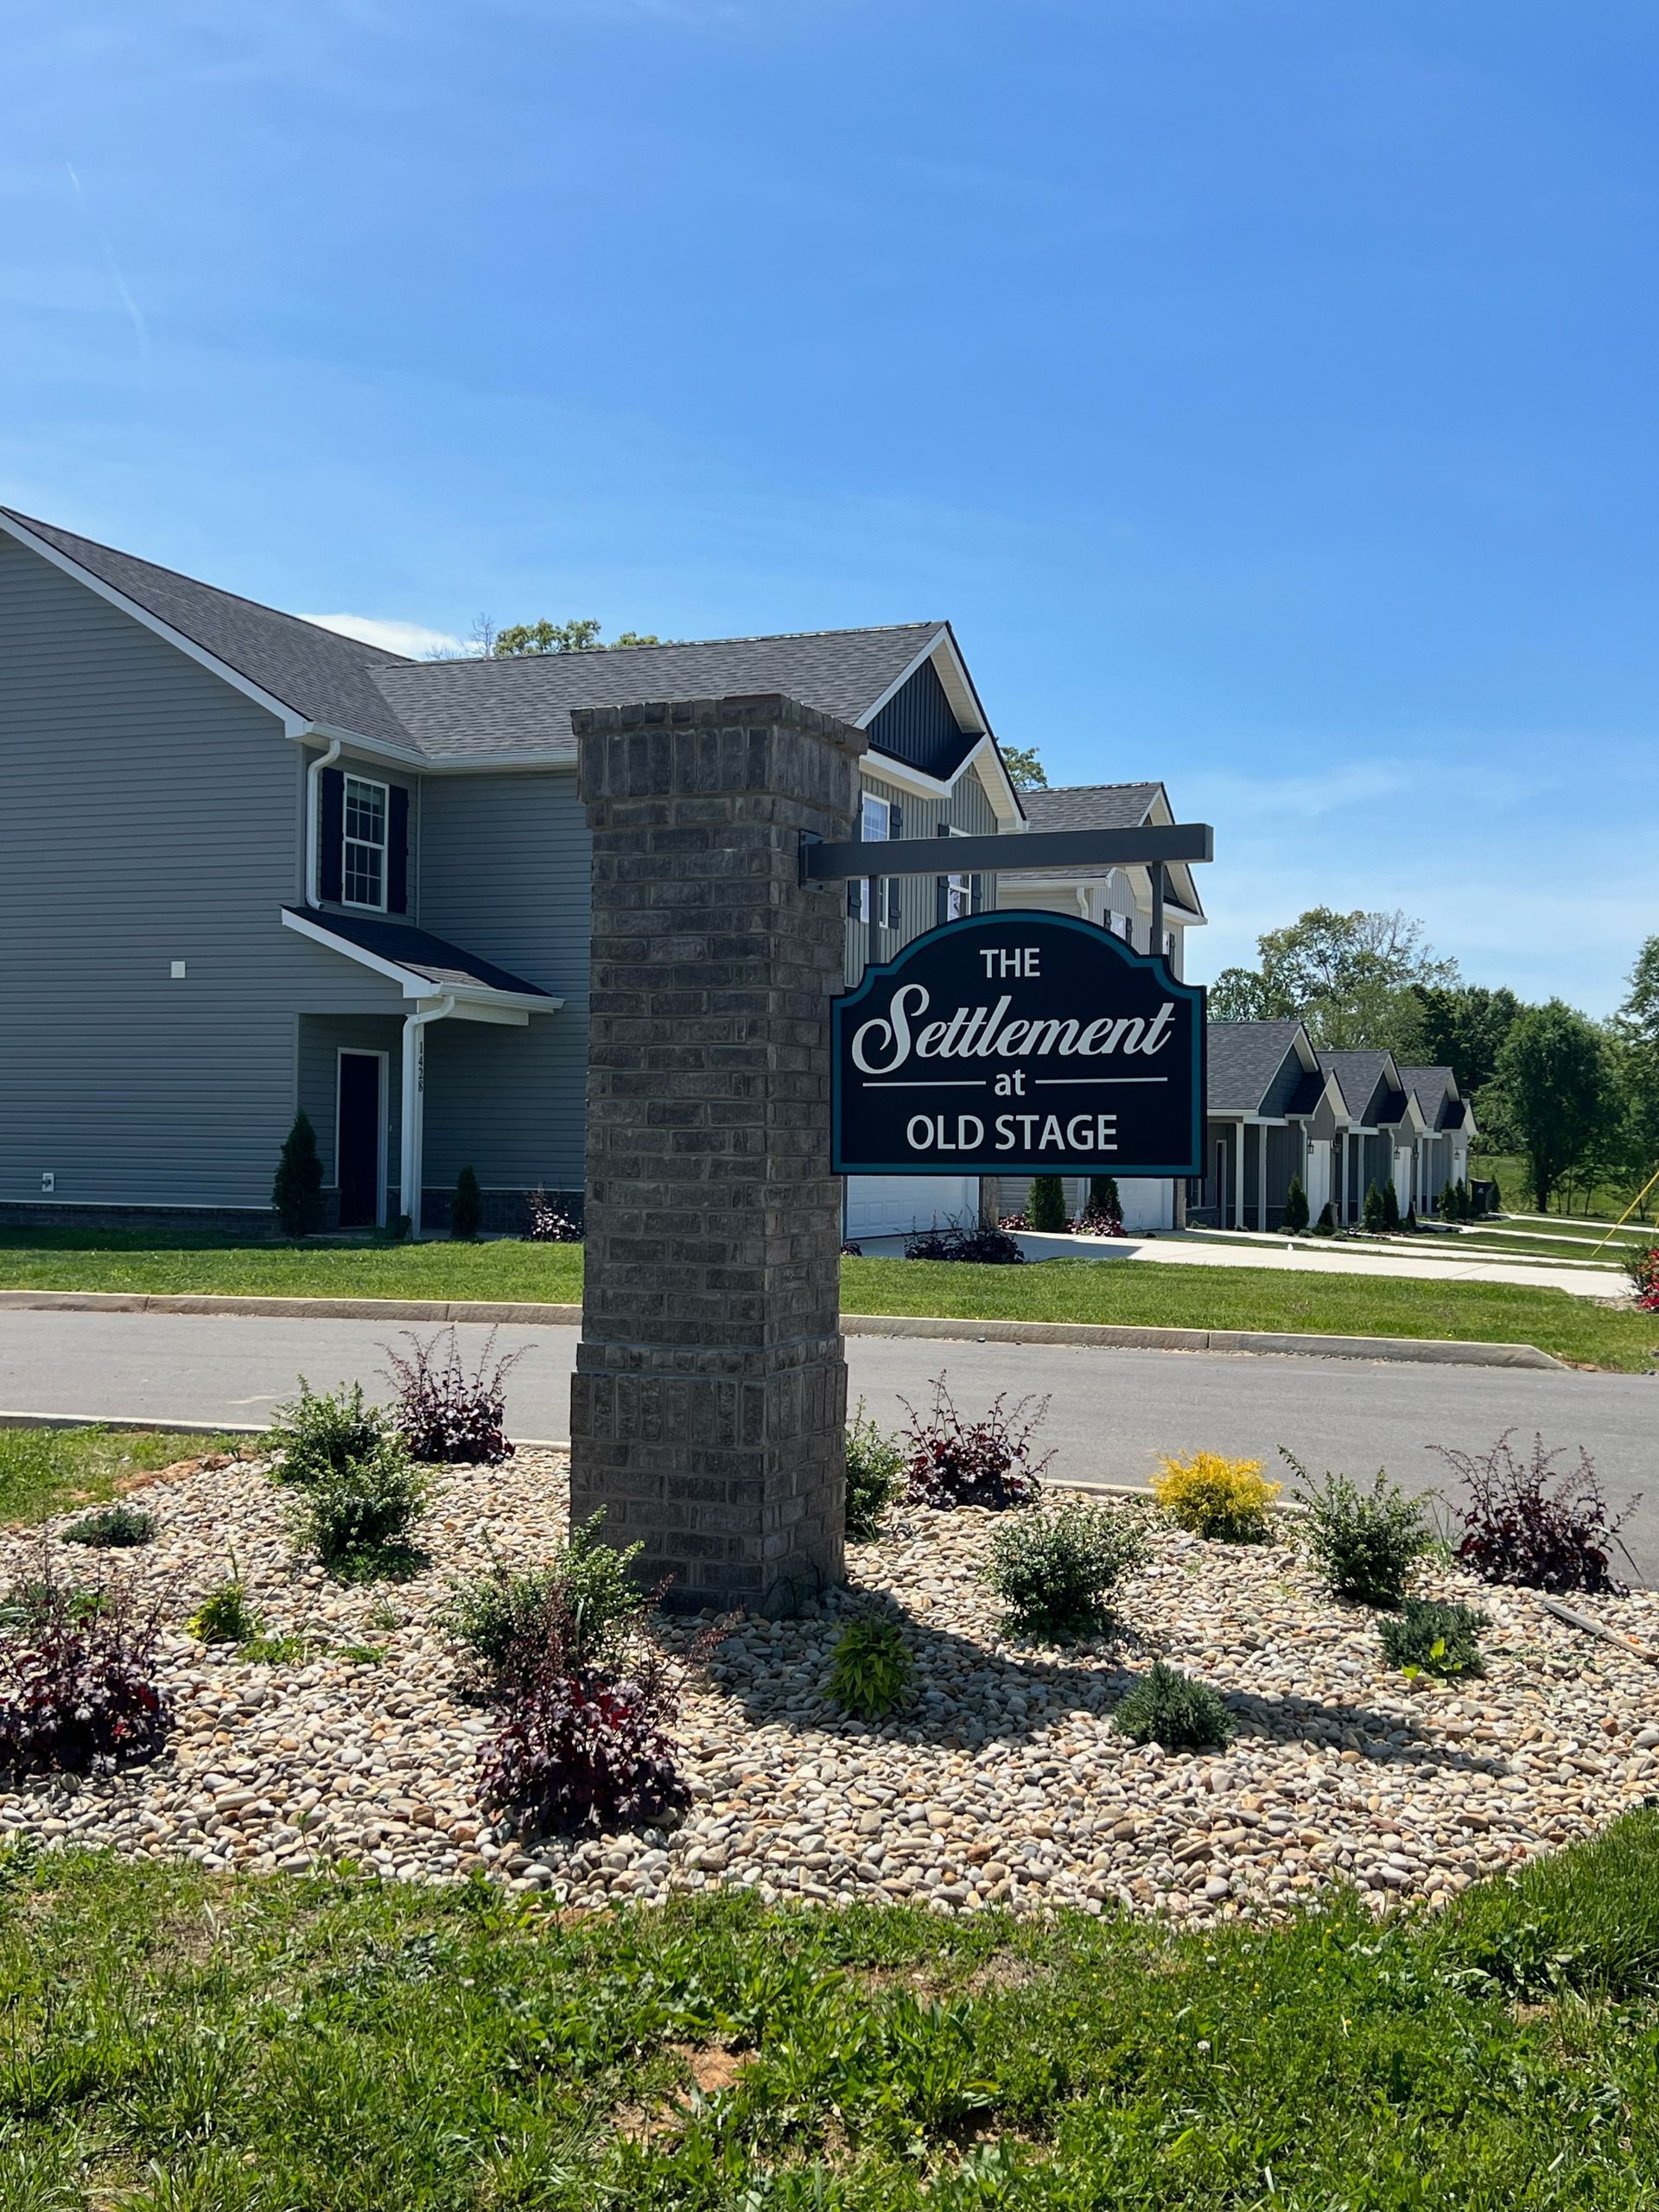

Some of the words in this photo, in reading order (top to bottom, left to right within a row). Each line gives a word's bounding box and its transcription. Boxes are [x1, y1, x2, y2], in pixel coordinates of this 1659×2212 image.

[979, 947, 1040, 978] THE
[851, 983, 1176, 1075] Settlement
[994, 1069, 1027, 1096] at
[906, 1115, 984, 1151] OLD
[995, 1114, 1118, 1151] STAGE
